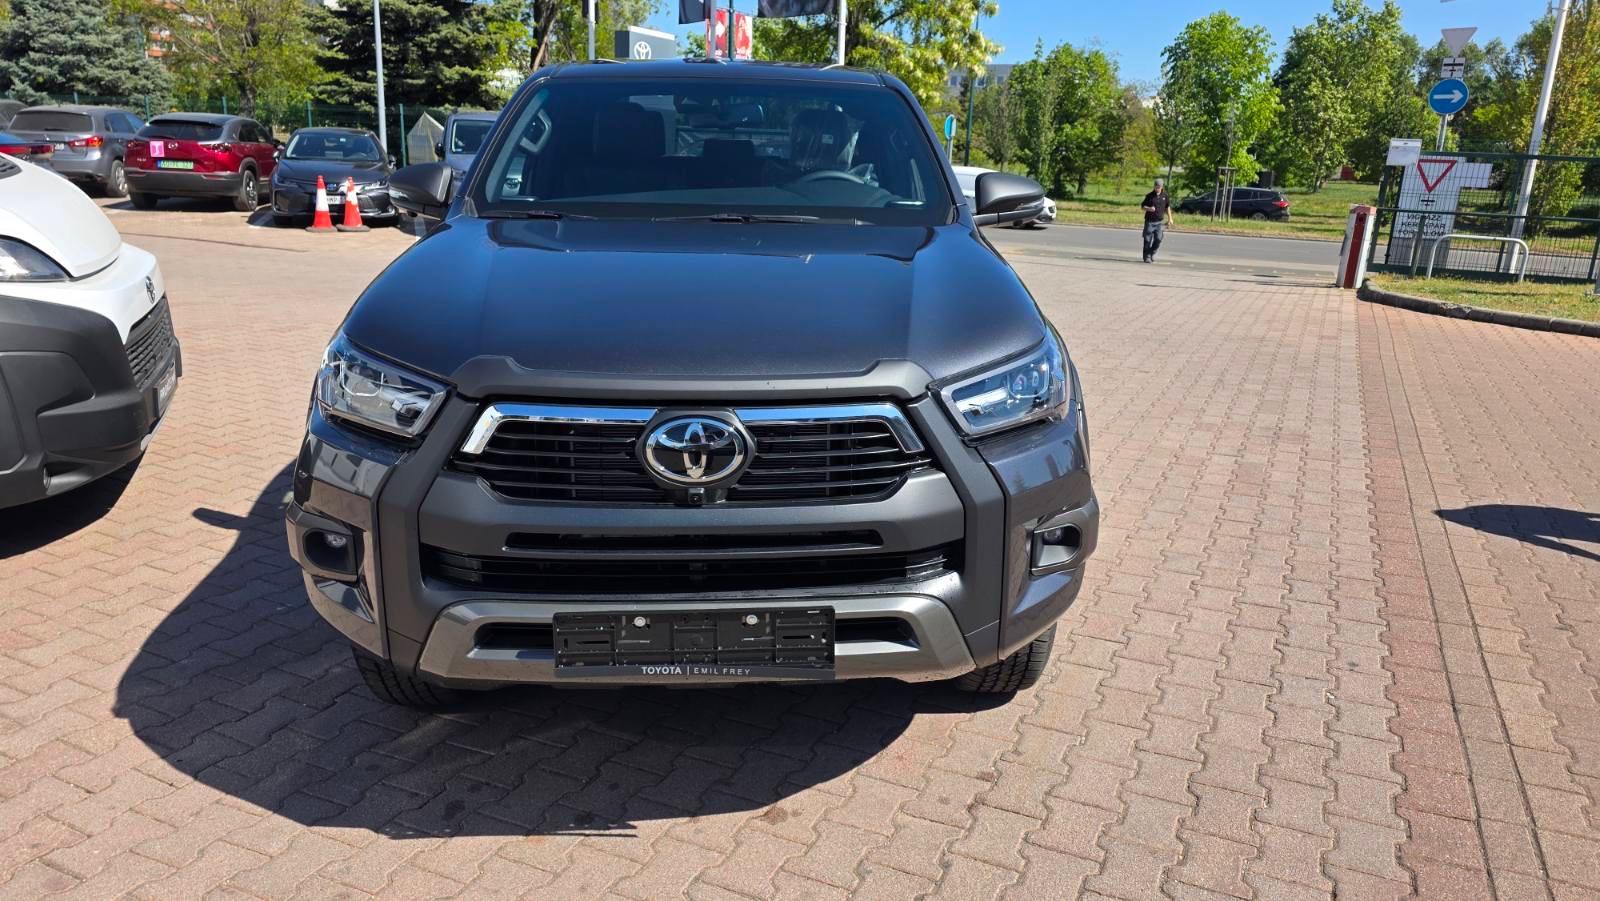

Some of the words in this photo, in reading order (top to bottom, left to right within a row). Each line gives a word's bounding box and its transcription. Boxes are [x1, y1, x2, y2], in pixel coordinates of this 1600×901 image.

[641, 666, 682, 675] TOYOTA
[693, 667, 719, 675] EMIL
[722, 667, 751, 675] FREY
